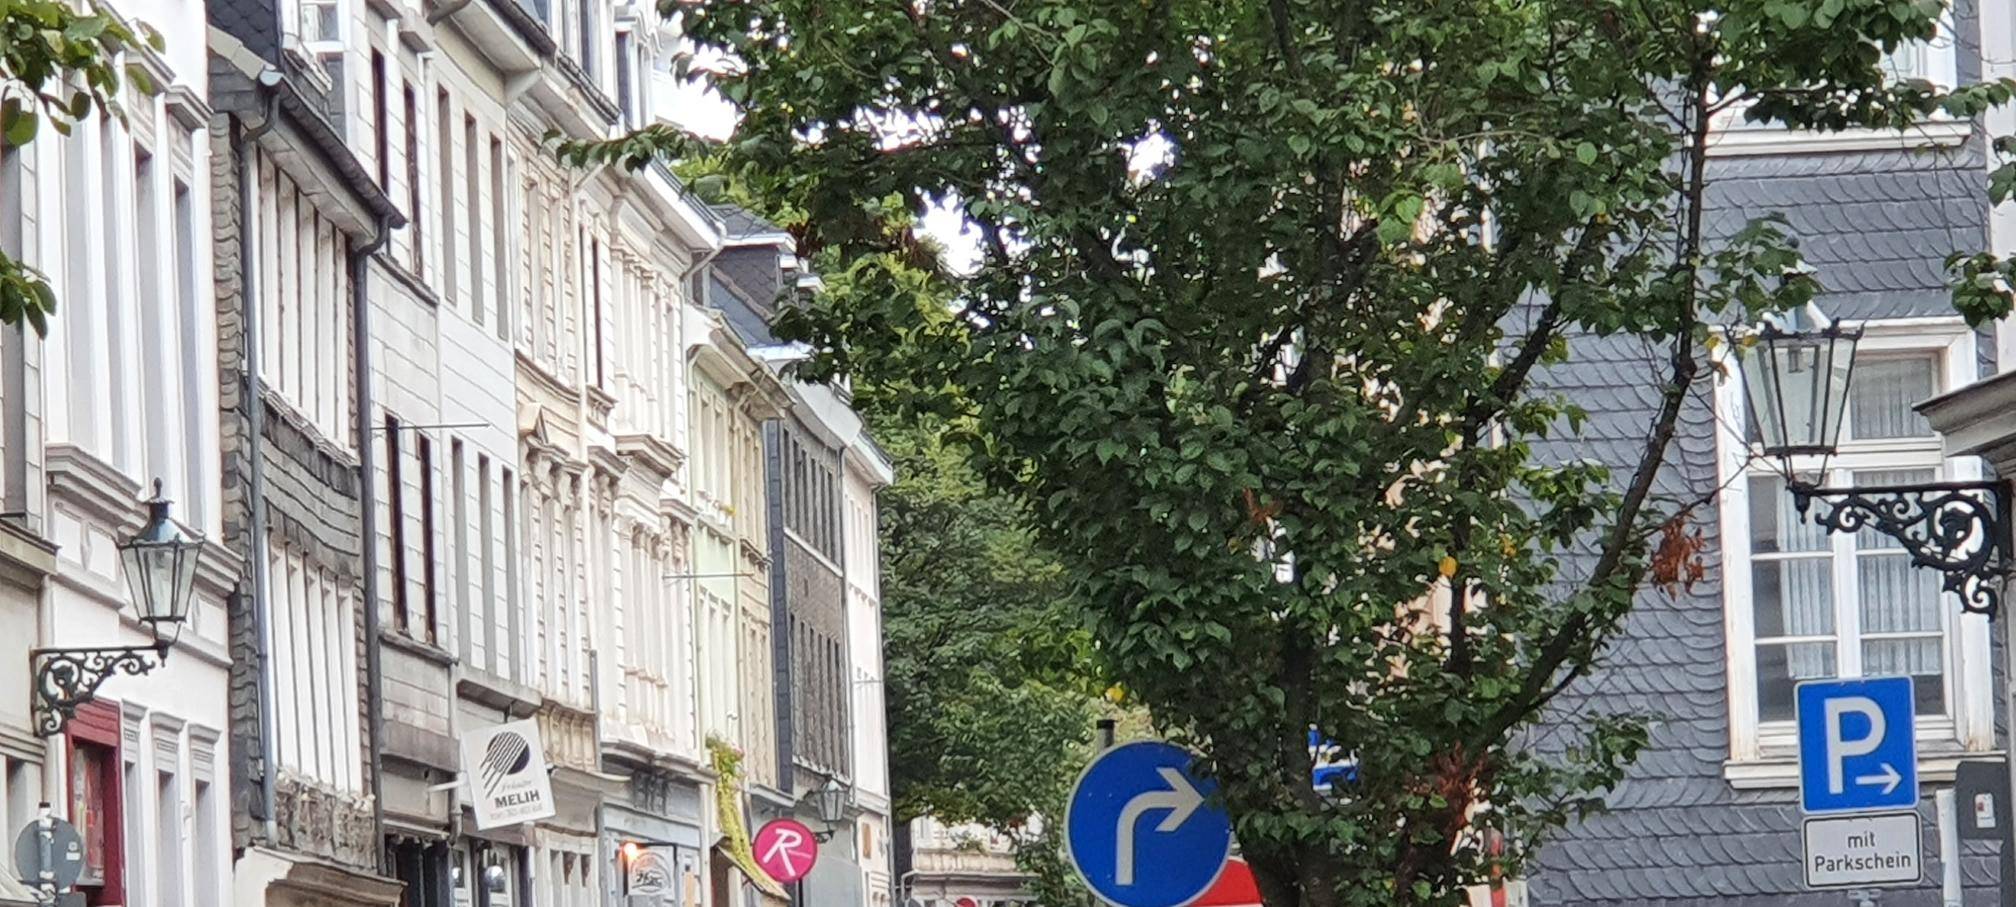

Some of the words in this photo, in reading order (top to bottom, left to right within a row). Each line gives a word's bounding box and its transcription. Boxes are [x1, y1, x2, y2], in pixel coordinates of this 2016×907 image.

[1824, 696, 1886, 794] P
[494, 789, 540, 808] MELIH
[1847, 831, 1876, 849] mit
[763, 828, 802, 877] R
[1814, 851, 1912, 873] Parkschein
